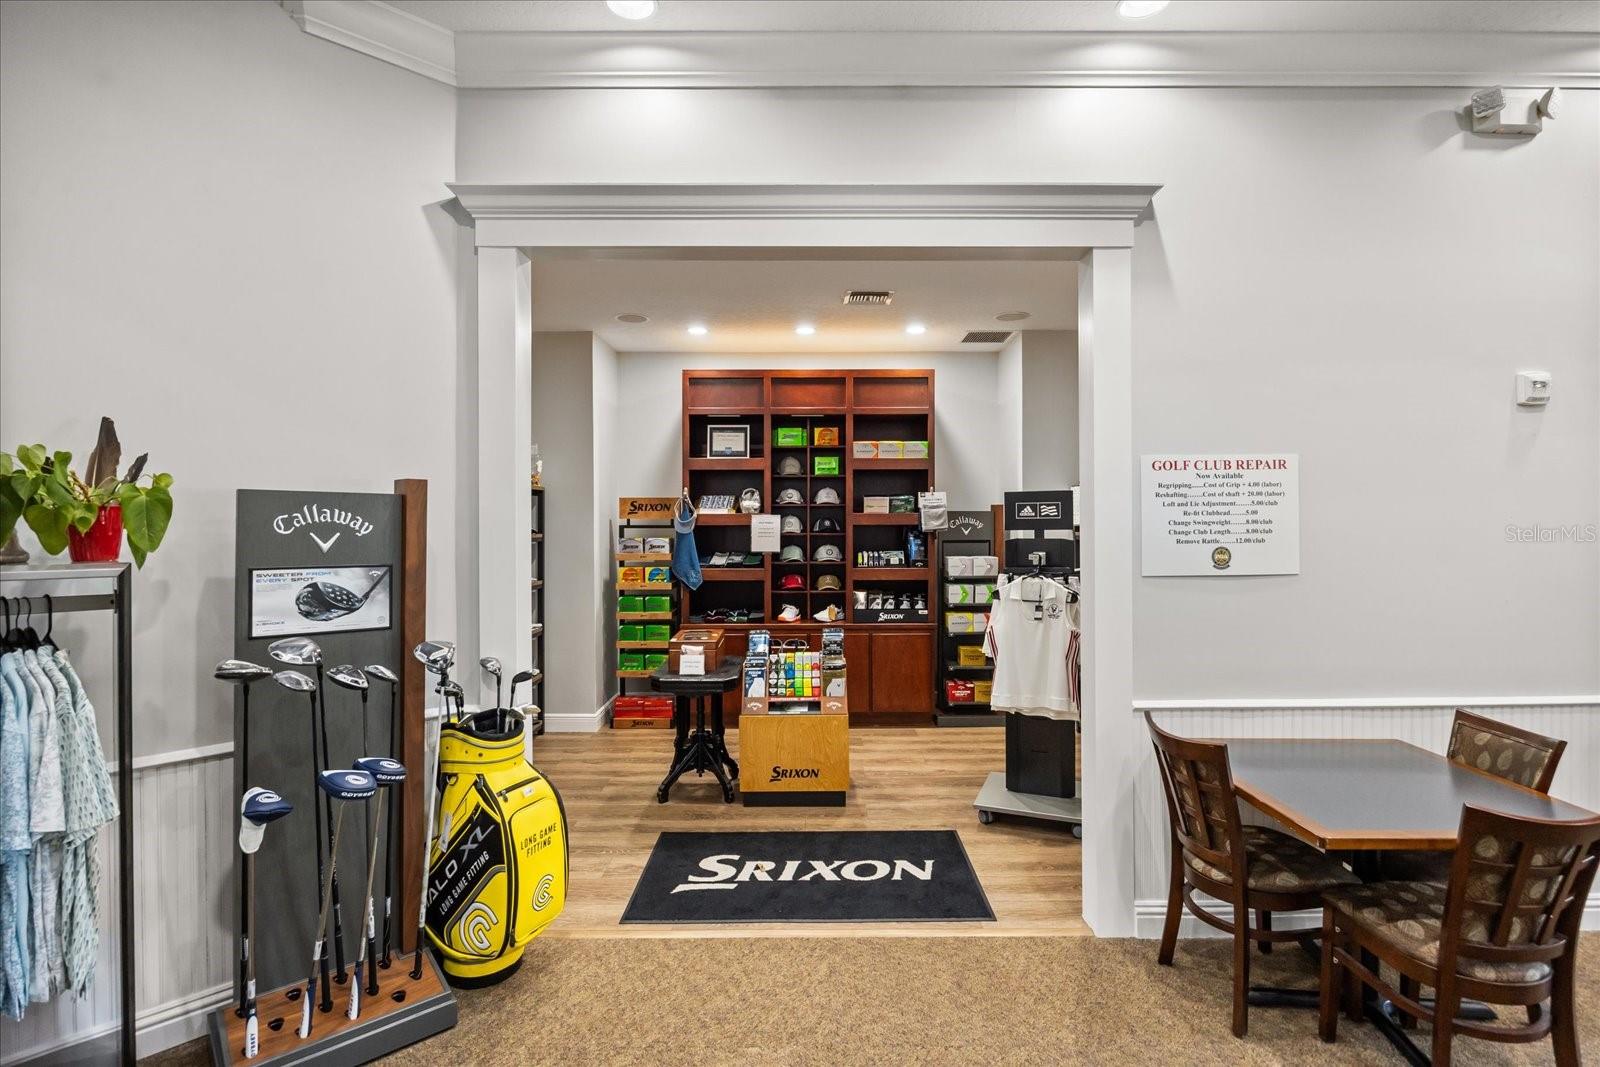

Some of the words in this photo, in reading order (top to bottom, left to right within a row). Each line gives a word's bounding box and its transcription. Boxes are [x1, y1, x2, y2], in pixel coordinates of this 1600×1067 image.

[1152, 460, 1190, 471] GOLF
[1194, 460, 1232, 471] CLUB
[1236, 459, 1287, 470] REPAIR
[1226, 481, 1241, 489] Grip
[628, 500, 671, 515] SRIXON
[273, 503, 374, 537] Callaway
[949, 515, 984, 529] Callaway
[1168, 519, 1191, 527] Change
[877, 611, 905, 622] SRIXON
[769, 765, 820, 782] SRIXON
[460, 824, 495, 863] XL
[520, 834, 537, 850] LONG
[539, 822, 557, 839] GAME
[526, 837, 552, 858] FITTING
[440, 895, 454, 915] LONG
[452, 877, 468, 898] GAME
[466, 850, 490, 880] FITTING
[670, 854, 935, 894] SRIXON
